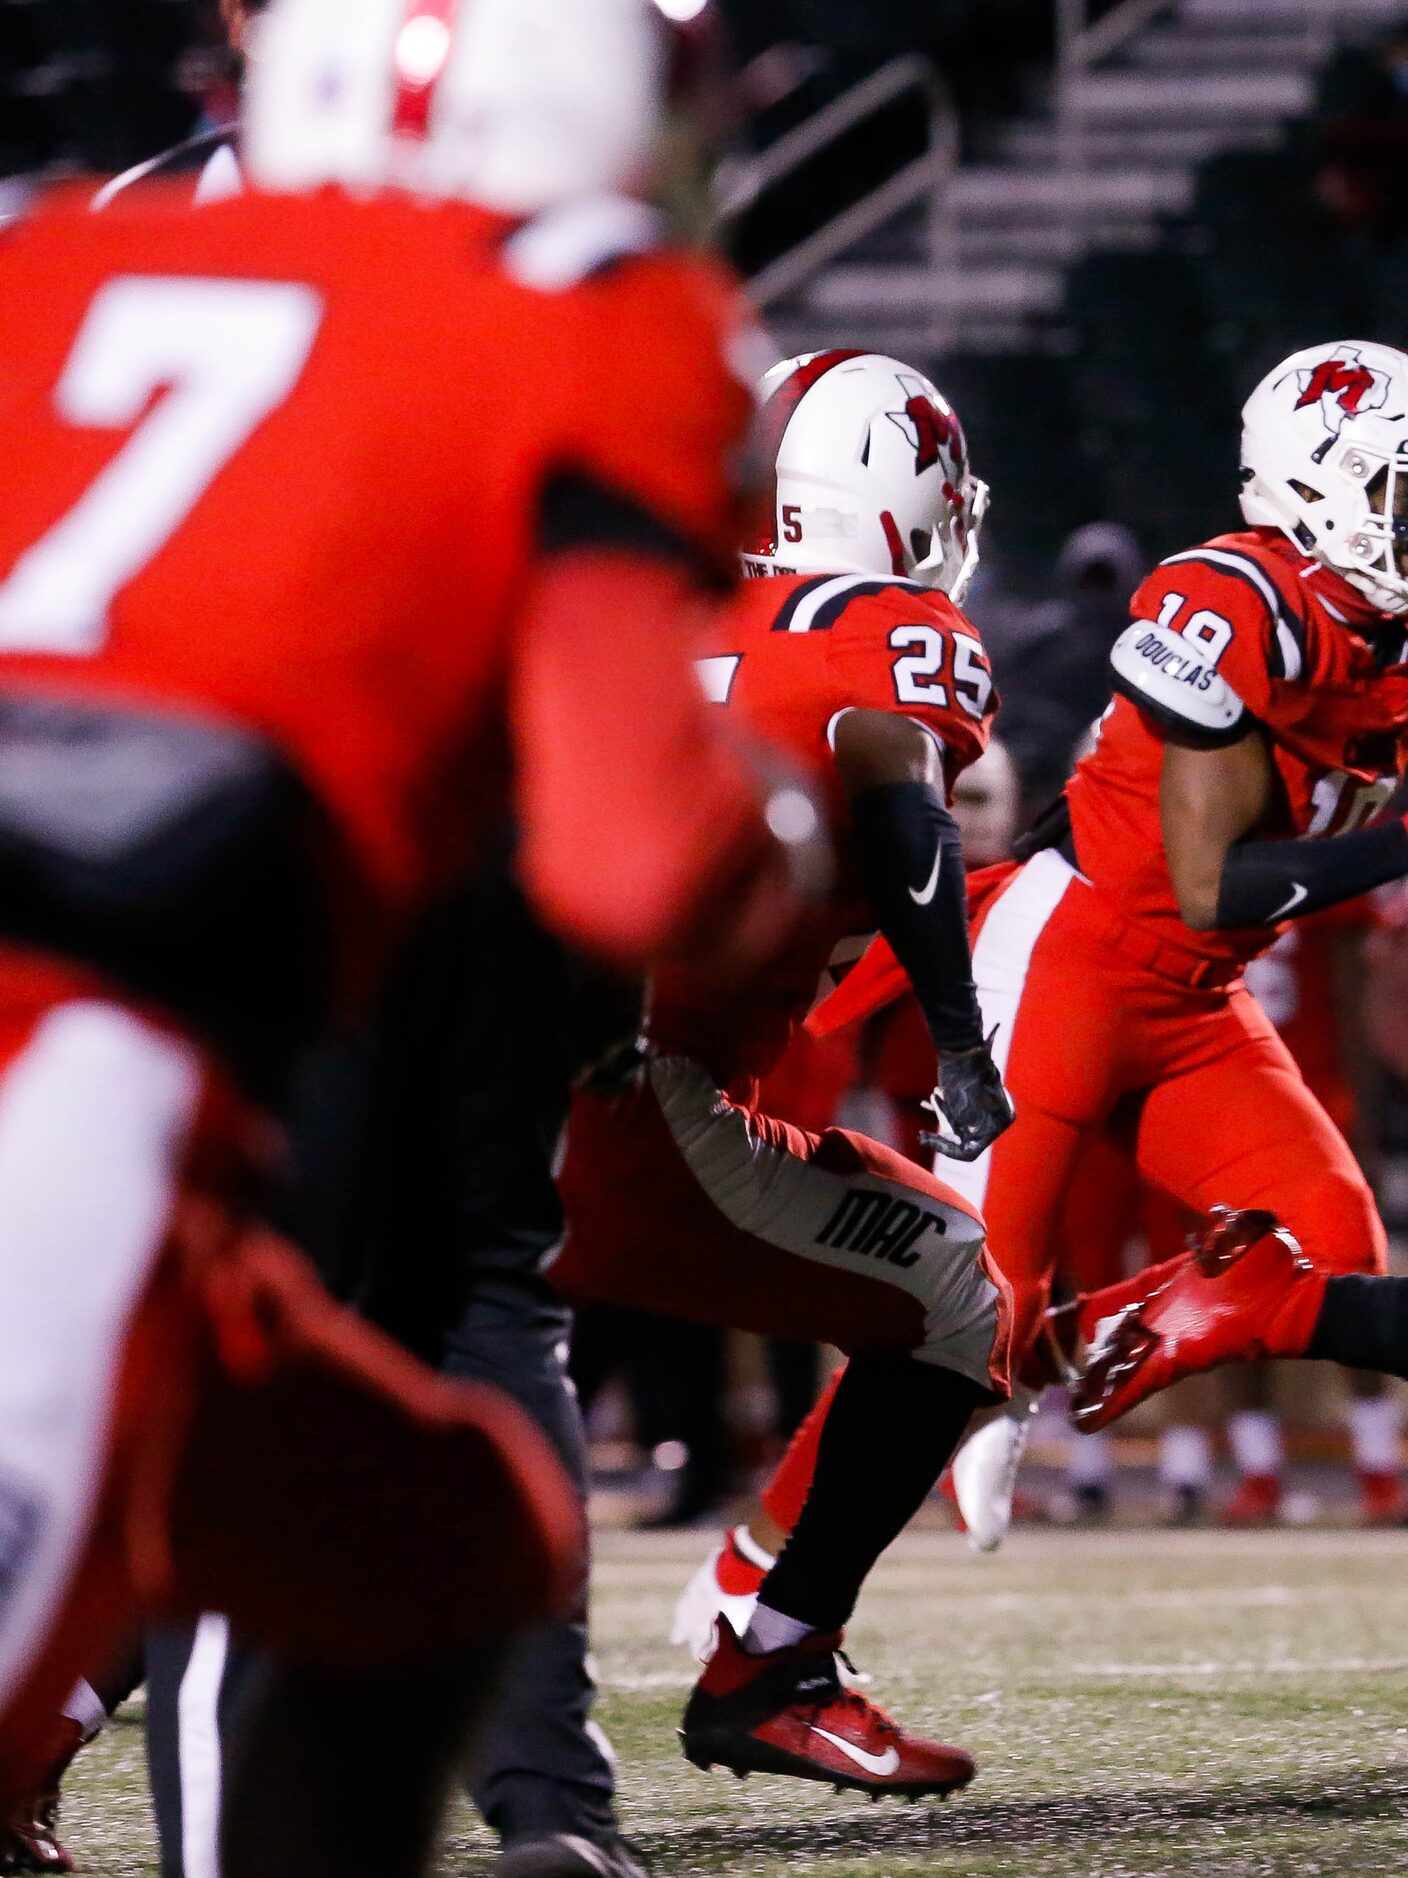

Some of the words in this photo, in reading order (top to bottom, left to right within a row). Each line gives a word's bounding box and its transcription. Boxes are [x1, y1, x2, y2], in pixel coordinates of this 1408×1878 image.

[0, 273, 327, 659] 7
[782, 505, 803, 543] 5
[887, 624, 993, 721] 25
[814, 1188, 948, 1268] MAC
